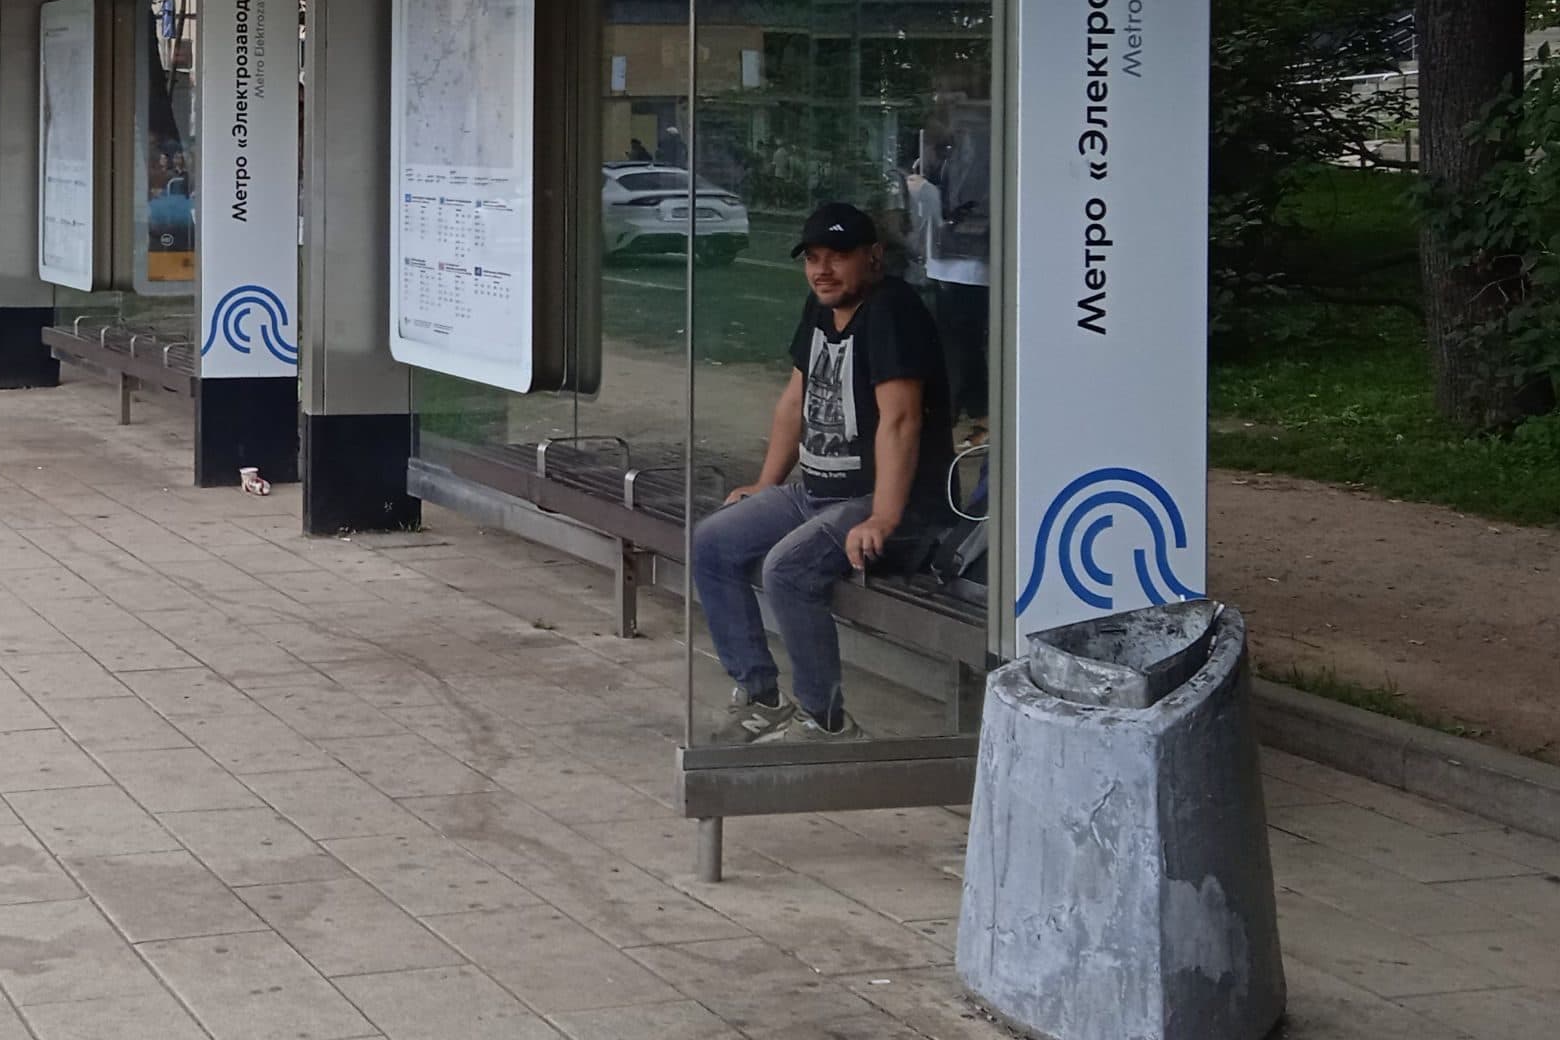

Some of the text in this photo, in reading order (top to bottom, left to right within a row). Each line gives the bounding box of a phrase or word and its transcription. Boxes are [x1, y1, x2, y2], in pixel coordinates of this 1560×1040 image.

[254, 57, 265, 98] Metro
[232, 156, 250, 222] Метро
[1077, 197, 1114, 335] Метро
